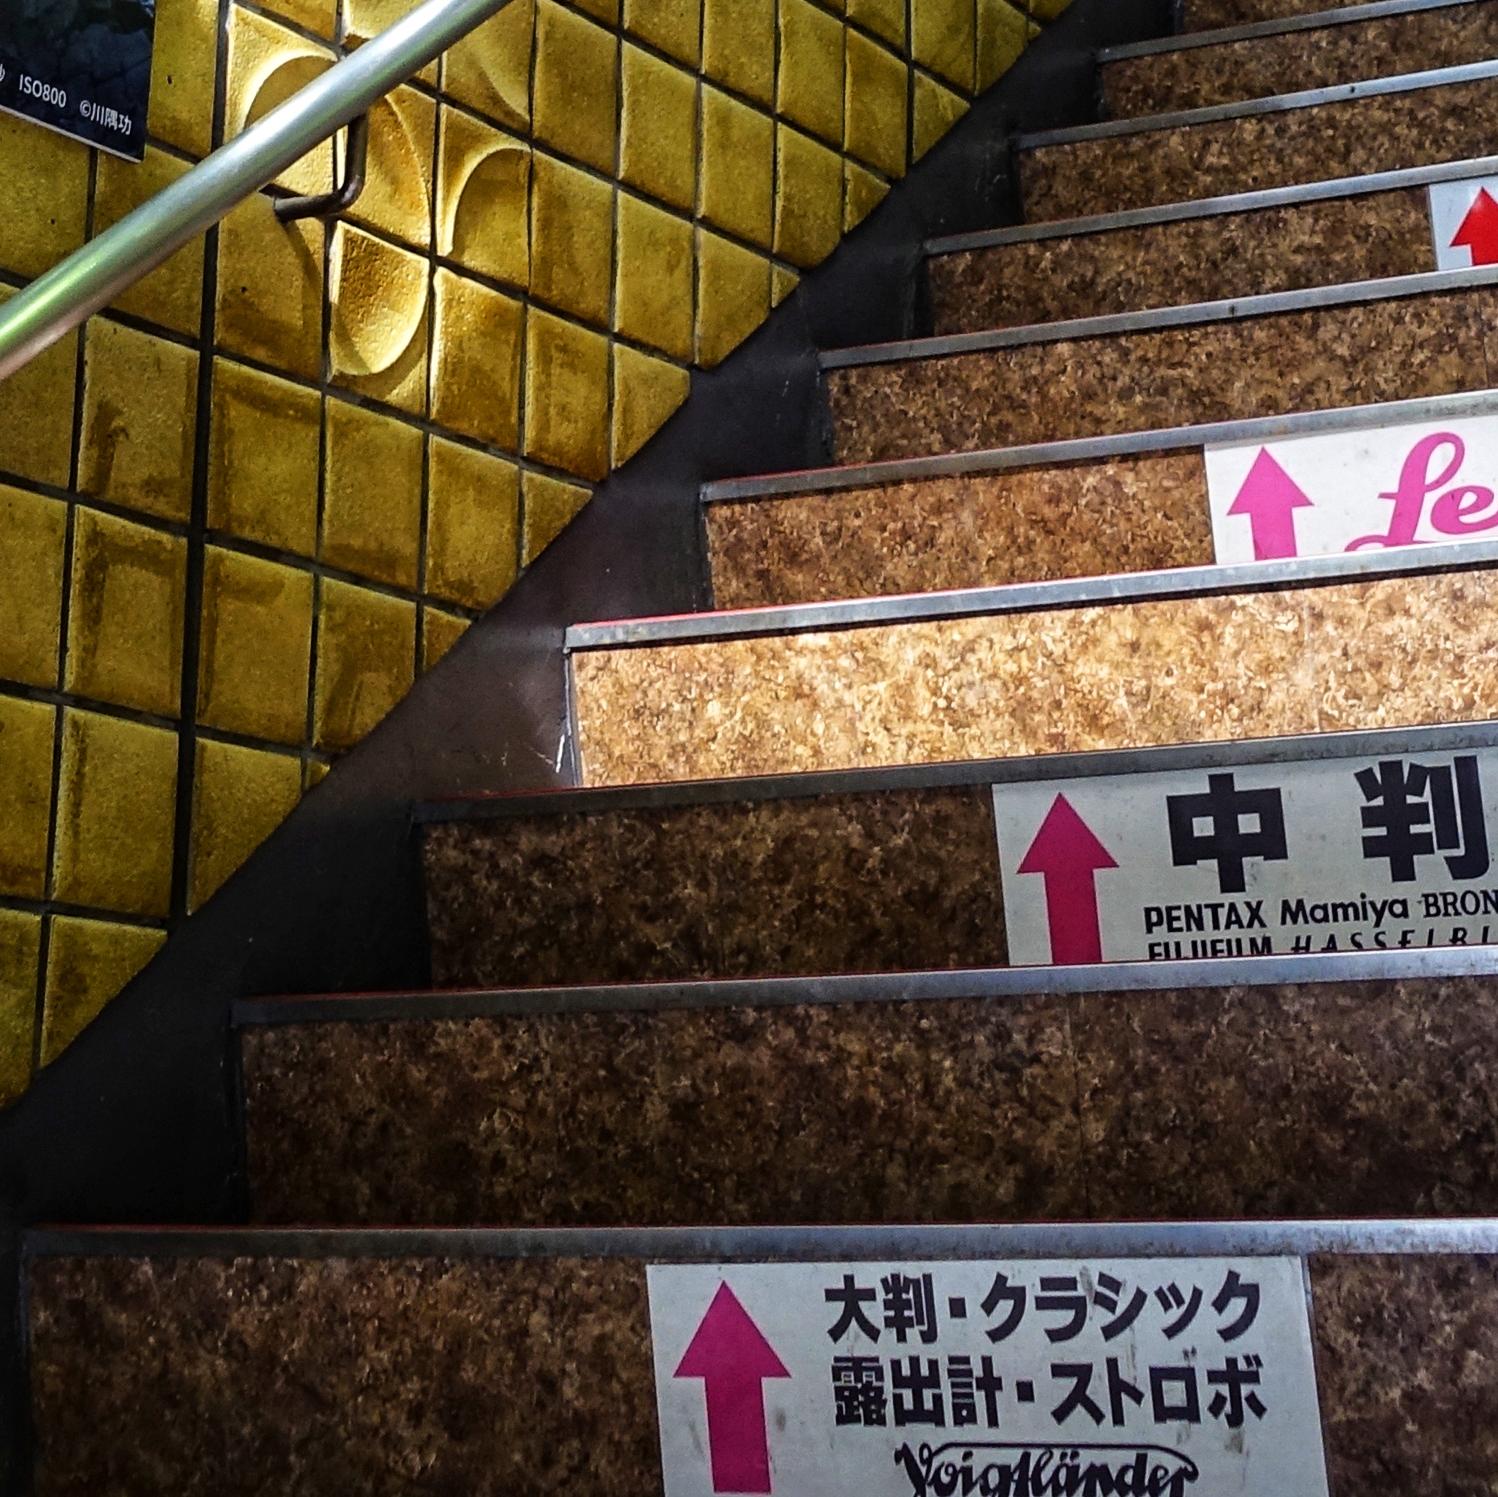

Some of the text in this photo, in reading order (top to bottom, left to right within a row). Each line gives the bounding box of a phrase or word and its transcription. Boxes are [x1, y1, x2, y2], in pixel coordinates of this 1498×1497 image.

[19, 74, 67, 108] ISO800
[1166, 755, 1491, 894] 中判
[1144, 899, 1266, 934] PENTAX
[1279, 892, 1409, 929] Mamiya
[824, 1269, 1261, 1344] 大判・クラシック
[831, 1353, 1268, 1428] 露出計・ストロボ
